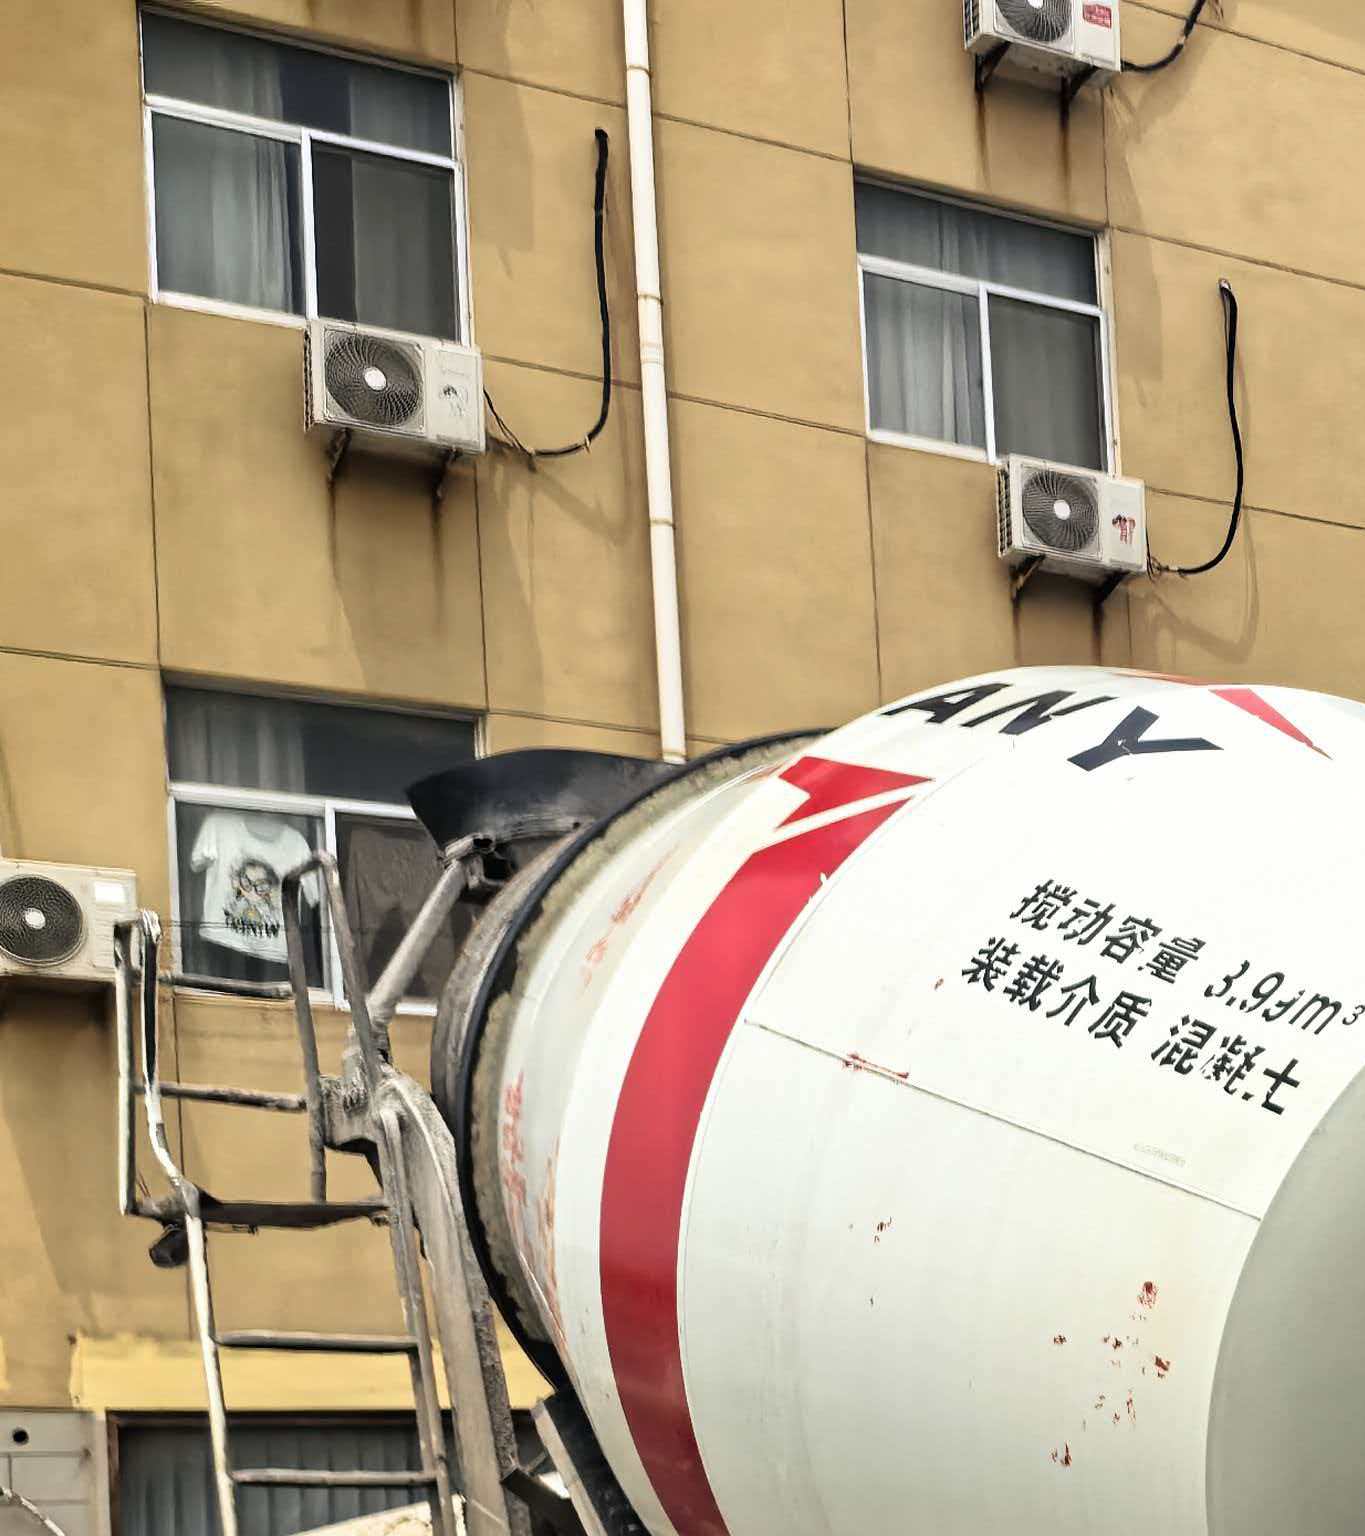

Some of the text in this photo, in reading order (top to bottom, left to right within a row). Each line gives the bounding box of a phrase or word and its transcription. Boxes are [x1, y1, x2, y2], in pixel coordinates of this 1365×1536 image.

[1009, 879, 1207, 984] 搅动容量
[961, 936, 1300, 1115] 装载介质 混凝土
